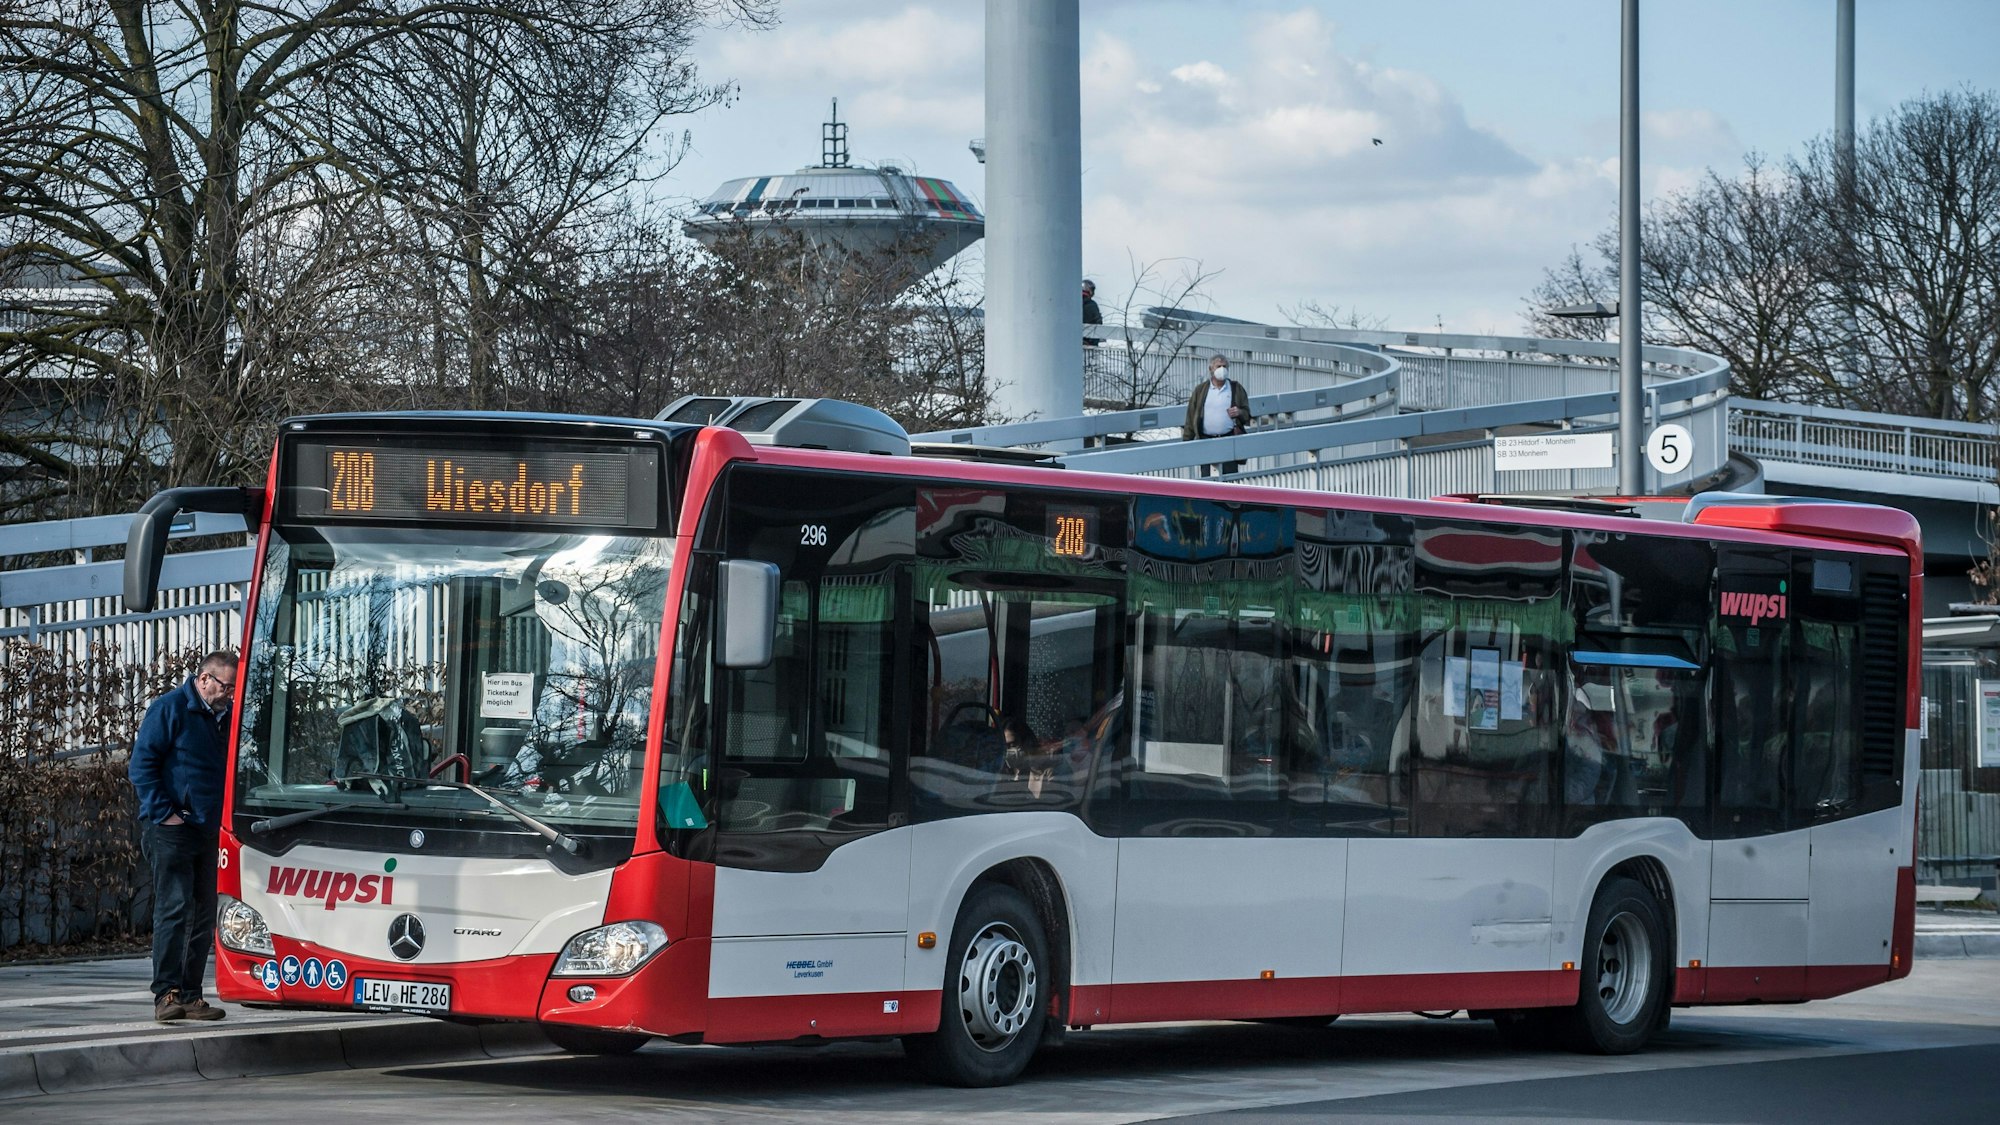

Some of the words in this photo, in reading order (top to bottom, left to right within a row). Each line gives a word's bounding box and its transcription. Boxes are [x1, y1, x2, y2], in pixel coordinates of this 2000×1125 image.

[1496, 439, 1507, 447] SB
[1508, 439, 1517, 447] 23
[1496, 450, 1507, 458] SB
[1660, 435, 1679, 464] 5
[331, 451, 375, 511] 208
[426, 460, 584, 515] Wiesdorf
[800, 524, 827, 546] 296
[1054, 516, 1086, 556] 208
[1720, 580, 1787, 626] wupsi
[511, 679, 523, 687] Bus
[487, 689, 520, 697] Ticketkauf
[486, 699, 513, 707] möglich!
[265, 857, 398, 911] wupsi
[453, 928, 502, 937] CITARO
[785, 960, 816, 969] HEBBEL
[816, 959, 834, 968] GmbH
[794, 970, 824, 979] Leverkusen
[364, 982, 391, 1003] LEV
[400, 985, 418, 1005] HE
[421, 986, 448, 1006] 286
